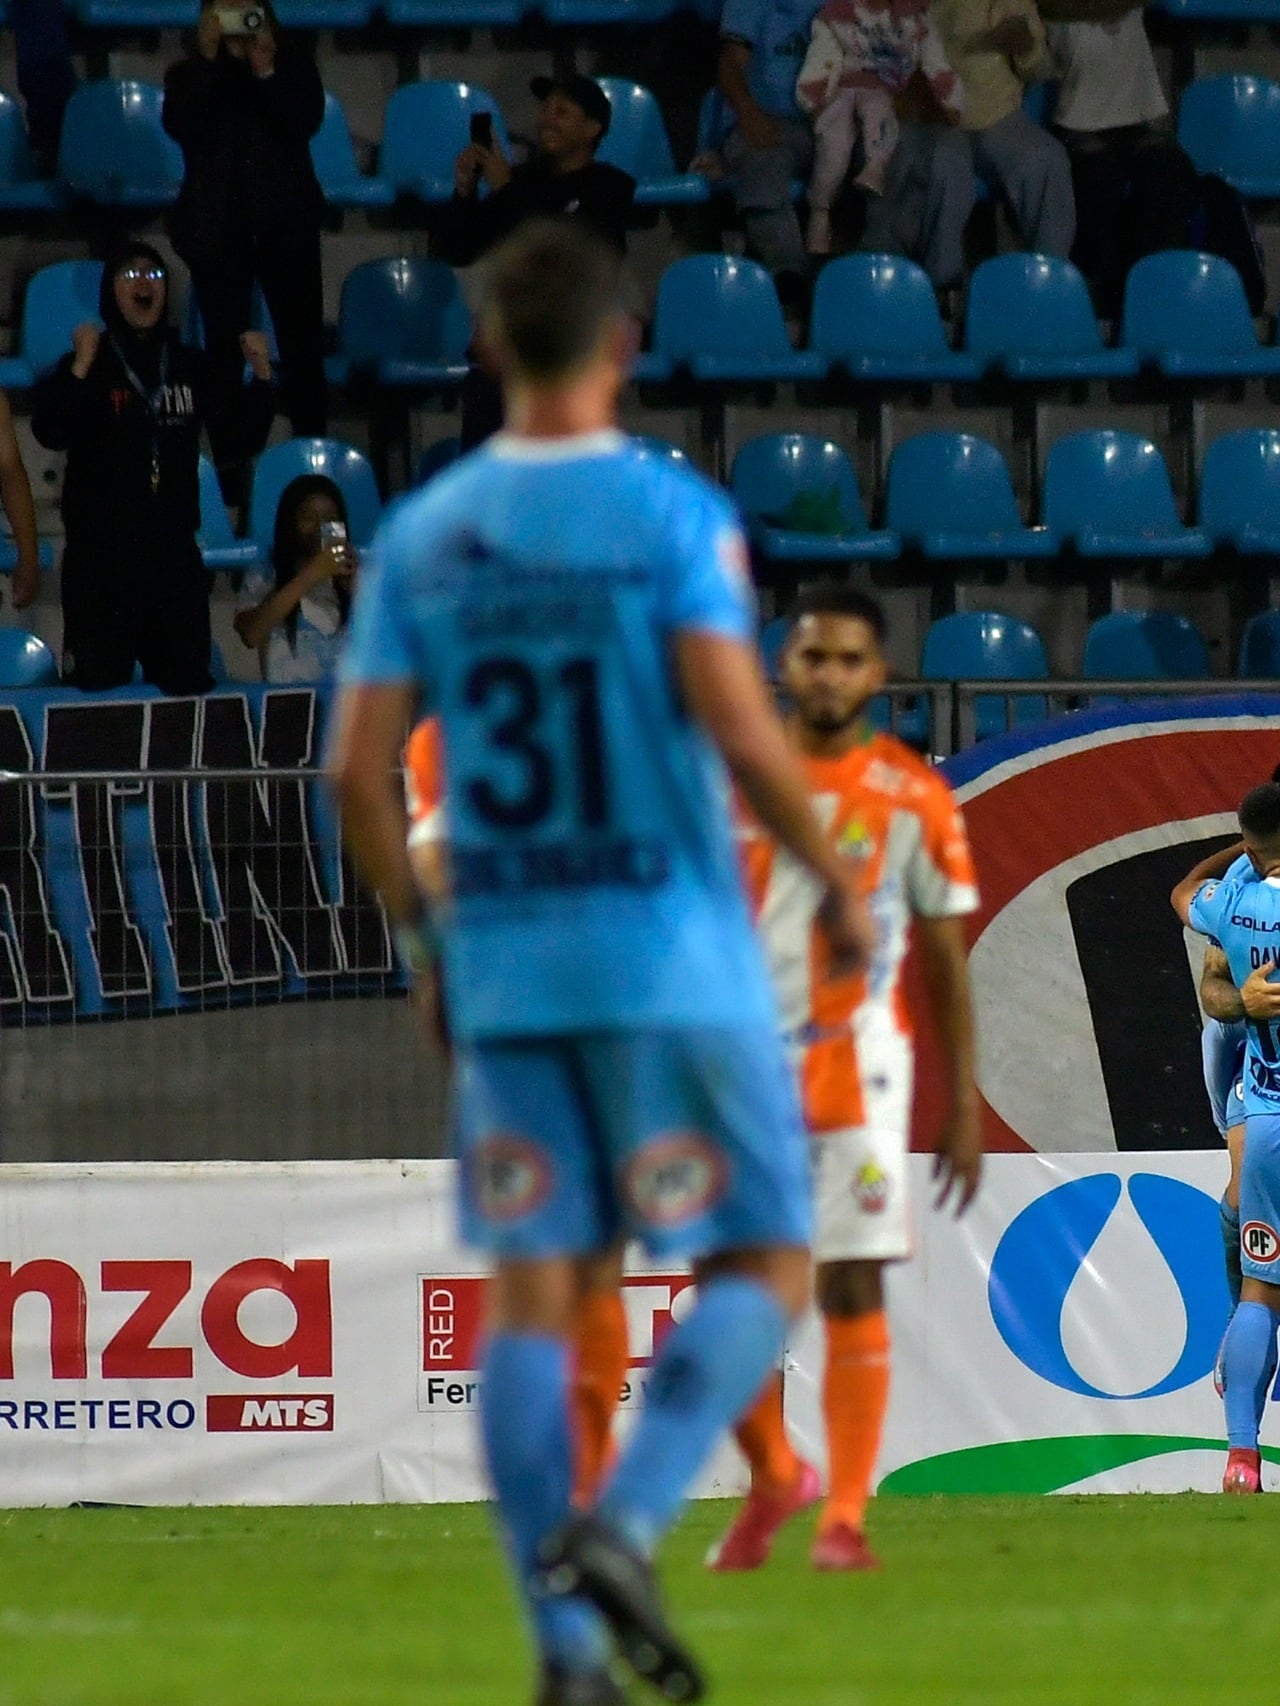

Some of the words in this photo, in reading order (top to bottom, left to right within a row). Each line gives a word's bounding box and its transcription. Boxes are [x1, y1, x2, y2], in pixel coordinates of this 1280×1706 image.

[464, 656, 608, 827] 31
[1249, 1228, 1271, 1255] PF
[0, 1258, 333, 1379] nza
[429, 1289, 454, 1360] RED
[240, 1400, 329, 1428] MTS
